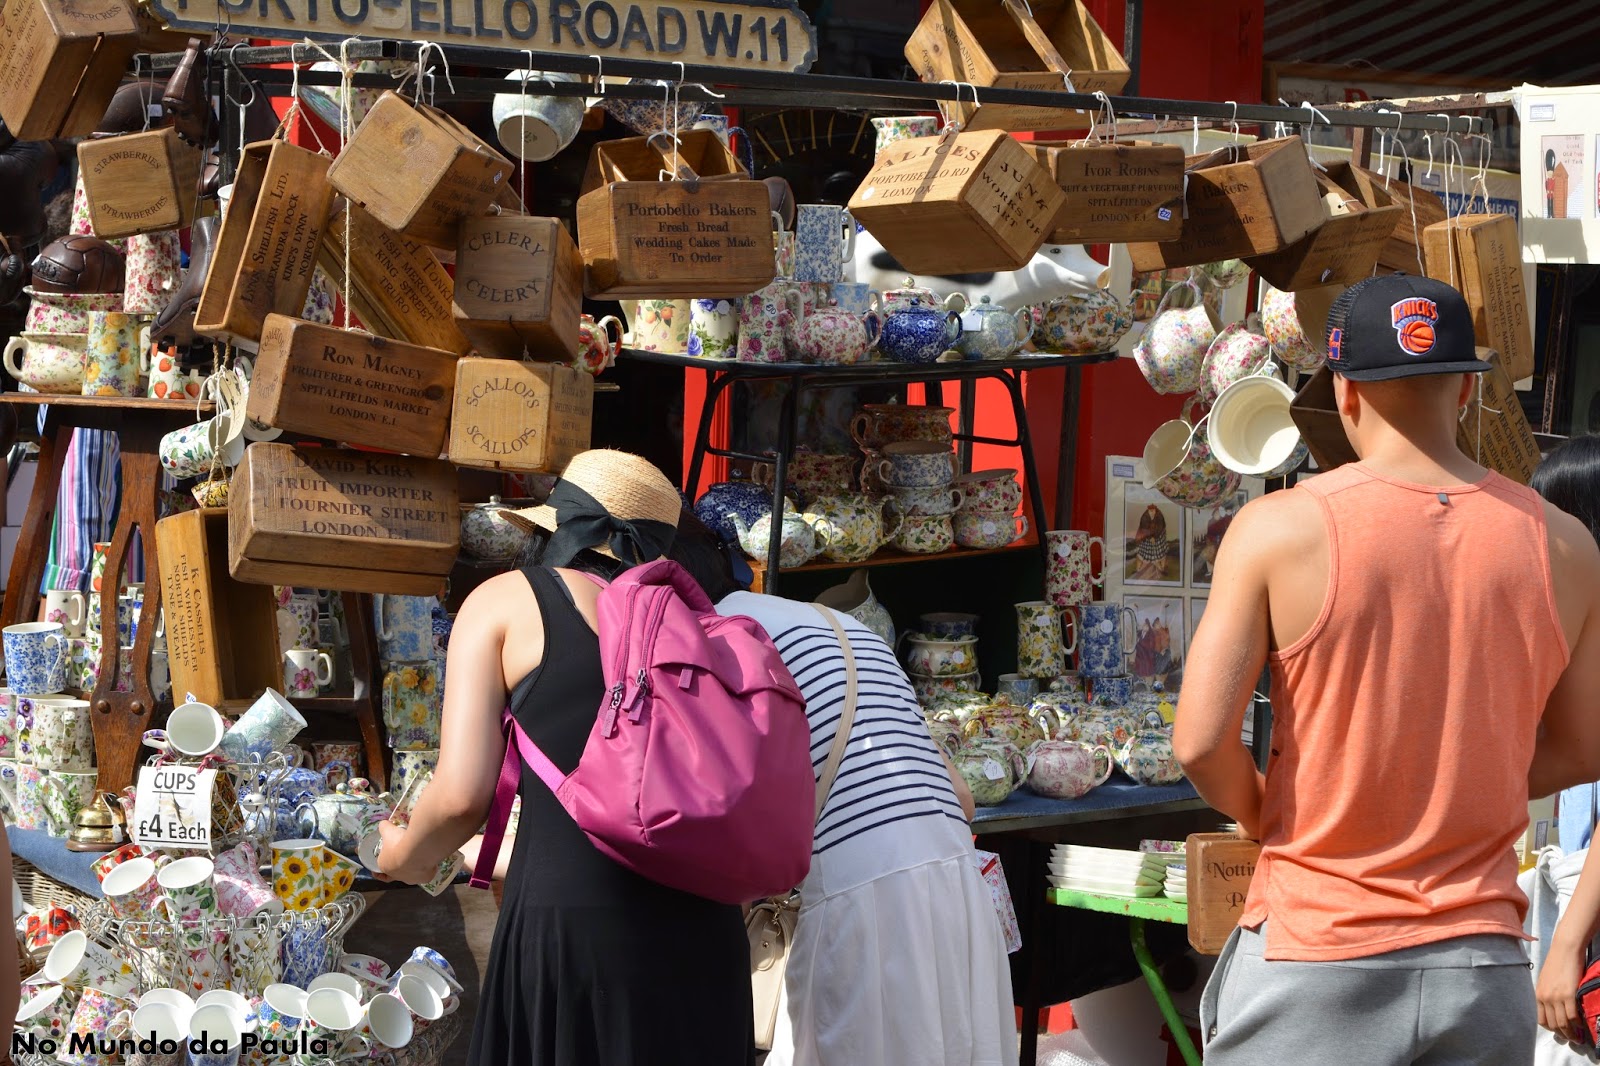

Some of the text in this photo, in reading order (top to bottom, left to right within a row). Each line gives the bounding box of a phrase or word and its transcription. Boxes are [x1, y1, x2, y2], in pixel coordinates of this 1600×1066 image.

[178, 0, 539, 41] OBELLO
[552, 0, 688, 53] ROAD
[697, 9, 789, 62] W.11
[935, 22, 977, 81] POMEGRANITES
[922, 49, 938, 83] POME
[93, 150, 162, 175] STRAWBERRIES
[876, 143, 981, 173] ALICES
[1084, 161, 1160, 177] IVOR ROBINS
[869, 166, 970, 186] PORTOBELLO RD
[1000, 162, 1049, 211] JUNK
[1060, 184, 1184, 193] RUIT & VEGETABLE PURVEYORS
[881, 184, 936, 199] LONDON
[981, 171, 1043, 236] WORKS OF
[1087, 198, 1153, 207] SPITALFIELDS
[1440, 196, 1459, 212] HEN
[1463, 200, 1485, 213] YOU
[101, 195, 168, 220] STRAWBERRIES
[252, 207, 279, 265] SHELLFISH
[270, 172, 290, 201] LTD.
[628, 202, 757, 217] Portobello Bakers
[992, 203, 1018, 228] ART
[1091, 213, 1129, 223] LONDON
[658, 221, 729, 233] Fresh Bread
[265, 193, 299, 292] ALEXANDRA DOCK
[282, 213, 309, 282] KING'S LYNN
[298, 228, 319, 278] NORFOLK
[468, 230, 545, 256] CELERY
[634, 236, 757, 250] Wedding Cakes Made
[669, 252, 722, 263] To Order
[375, 249, 435, 321] KING STREET
[379, 231, 451, 321] FISH MERCHANT
[1508, 265, 1517, 280] A.
[380, 275, 410, 314] TRURO
[466, 279, 540, 303] CELERY
[1488, 272, 1498, 313] LONDON
[1498, 243, 1517, 358] WHOLESALE FISHMONGER
[1511, 283, 1521, 300] H.
[1393, 299, 1438, 324] KNICKS
[1493, 266, 1507, 330] BILLINGSGATE
[1501, 330, 1512, 367] MARKET
[322, 345, 425, 380] RON MAGNEY
[292, 364, 444, 402] FRUITERER & GREENGRO
[466, 377, 540, 410] SCALLOPS
[301, 383, 432, 417] SPITALFIELDS MARKET
[329, 404, 377, 423] LONDON
[1504, 391, 1536, 458] IAN PERKES
[466, 425, 537, 455] SCALLOPS
[1485, 432, 1505, 473] BRIXHAM
[366, 458, 415, 479] KIRA
[1480, 445, 1492, 469] DEVO
[1501, 445, 1516, 472] QUAY
[339, 481, 433, 502] IMPORTER
[280, 497, 373, 517] FOURNIER
[381, 506, 448, 523] STREET
[302, 520, 378, 539] LONDON
[167, 574, 176, 609] TYNE
[172, 623, 182, 661] WEAR
[173, 564, 190, 667] NORTH SHIELDS
[180, 554, 198, 673] FISH WHOLESALER
[190, 567, 206, 655] K. CASSELLS
[154, 772, 196, 790] CUPS
[139, 813, 206, 840] £4 Each
